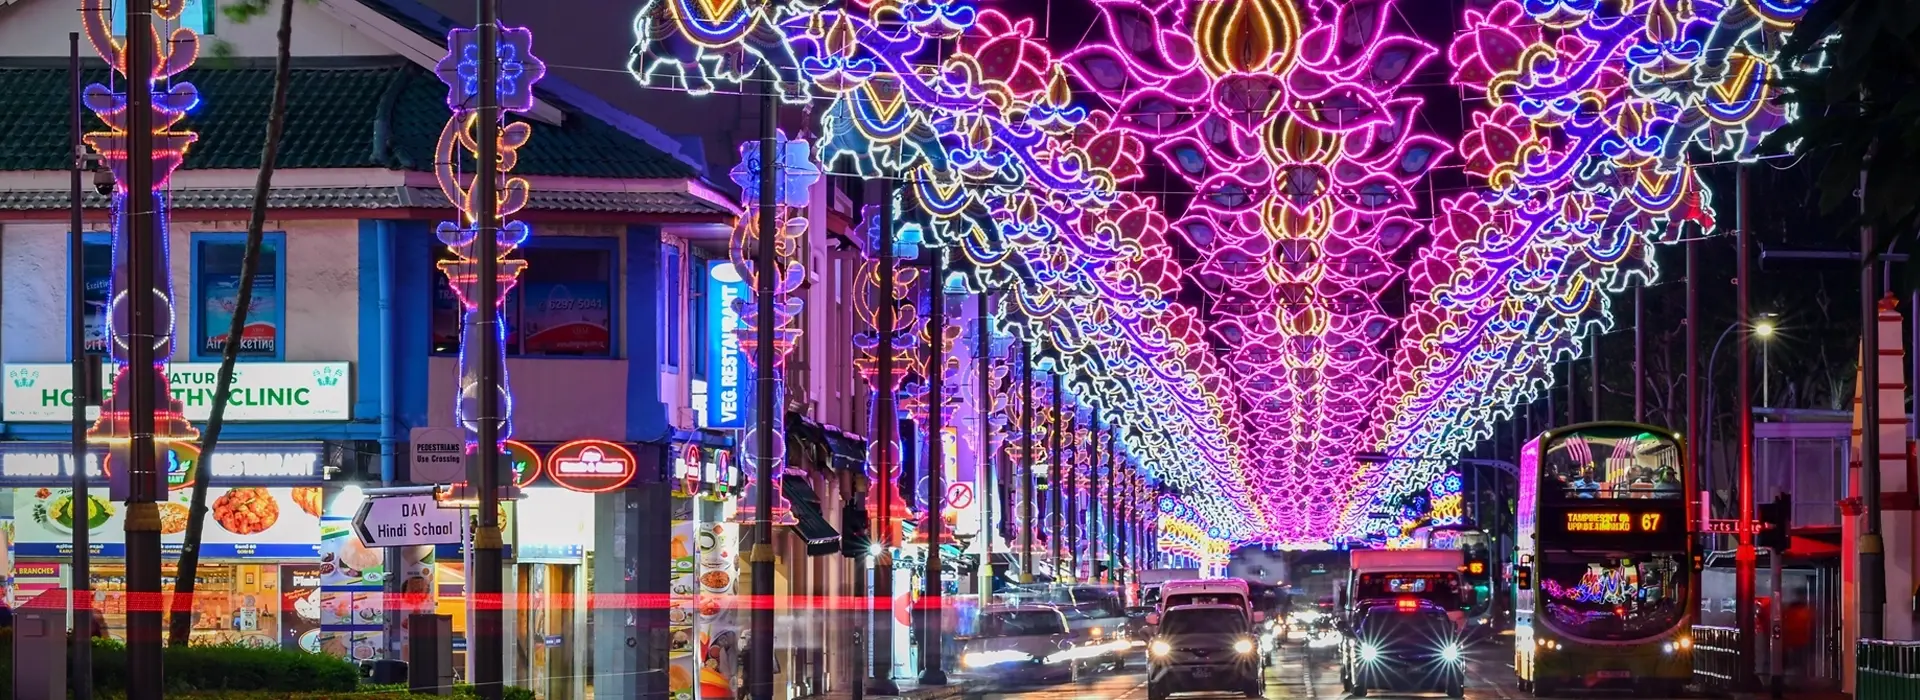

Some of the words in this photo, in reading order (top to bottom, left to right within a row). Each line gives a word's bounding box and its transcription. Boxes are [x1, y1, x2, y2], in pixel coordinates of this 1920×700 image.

[206, 336, 223, 349] Air
[228, 387, 310, 406] CLINIC
[721, 388, 738, 423] VEG.
[417, 443, 459, 451] PEDESTRIANS
[417, 455, 429, 463] Use
[431, 455, 460, 464] Crossing
[402, 503, 426, 517] DAV
[378, 523, 407, 538] Hindi
[414, 521, 453, 536] School
[1642, 513, 1660, 531] 67
